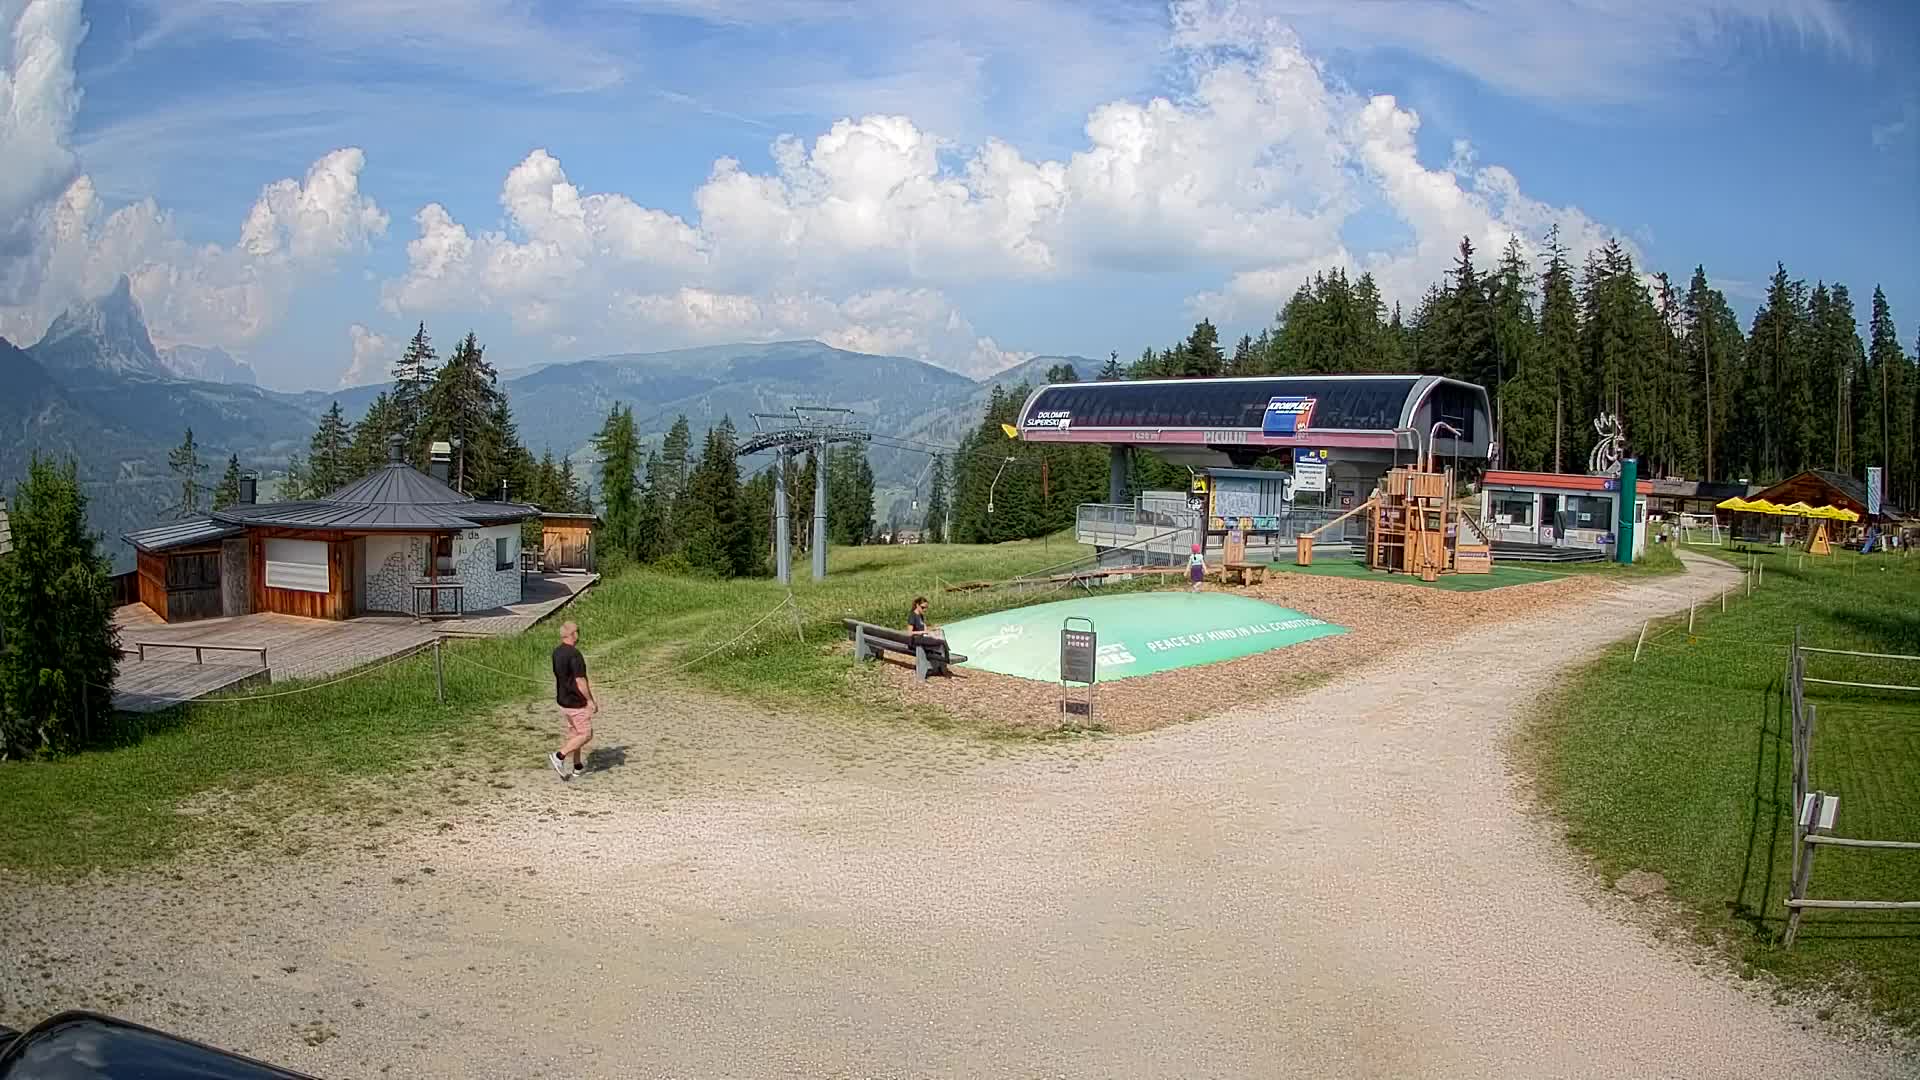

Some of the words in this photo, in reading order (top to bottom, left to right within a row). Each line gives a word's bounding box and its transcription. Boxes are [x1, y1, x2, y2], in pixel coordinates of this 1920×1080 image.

[1027, 418, 1059, 426] SUPERSKI
[1203, 432, 1248, 443] PICULIN
[1146, 636, 1190, 652] PEACE
[1188, 633, 1206, 644] OF
[1206, 629, 1237, 641] MIND
[1235, 627, 1251, 637] IN
[1250, 624, 1271, 634] ALL
